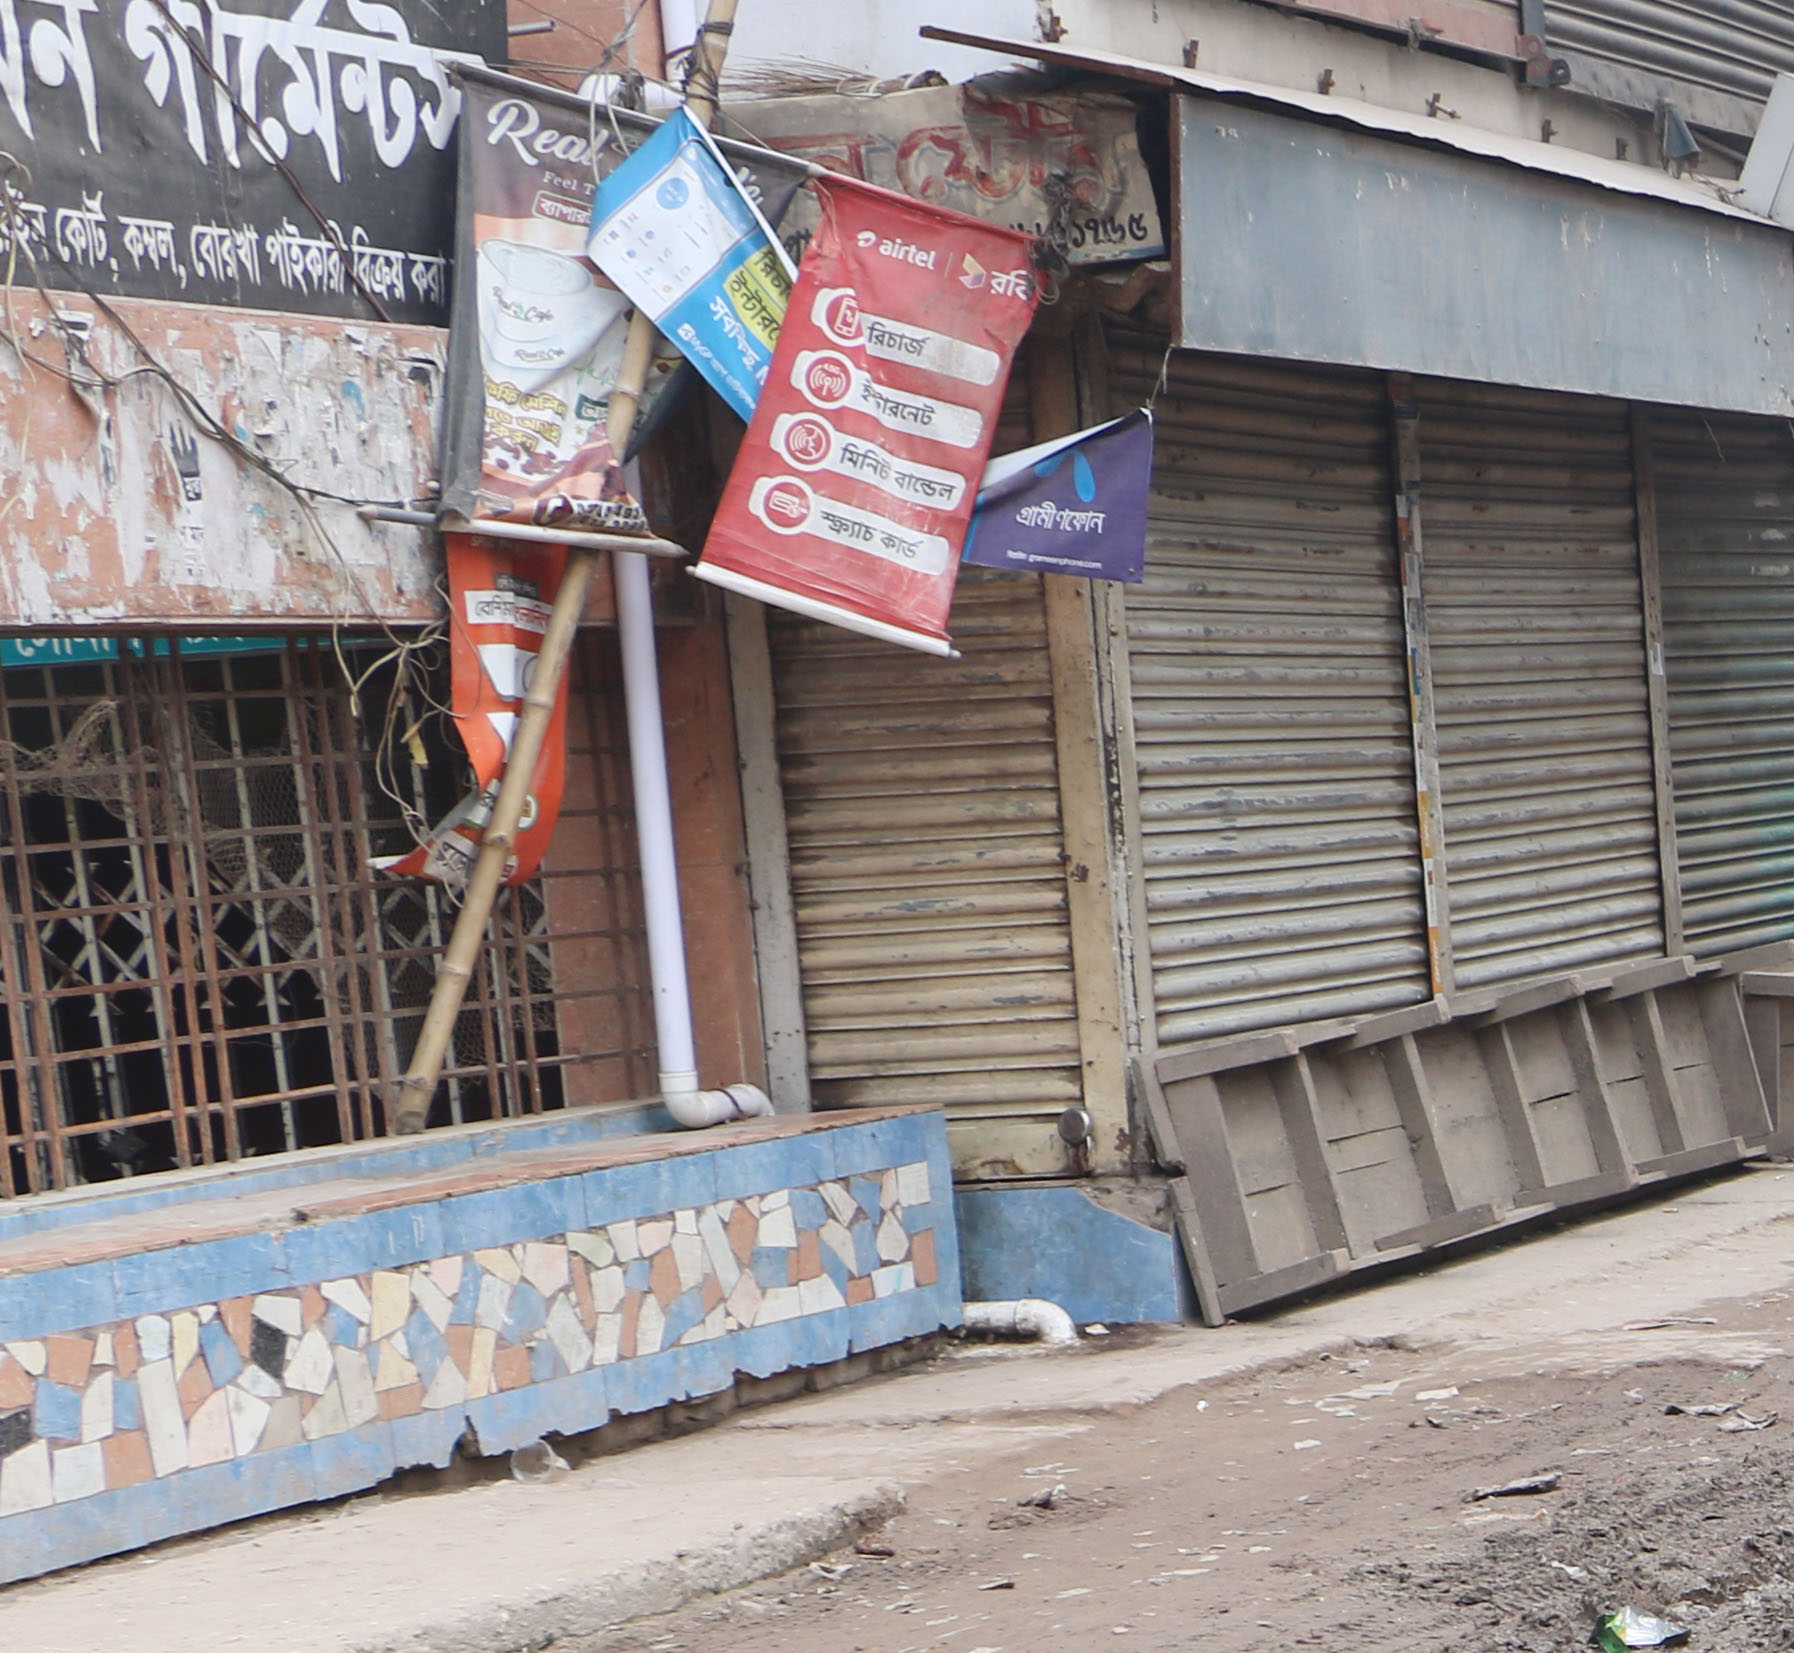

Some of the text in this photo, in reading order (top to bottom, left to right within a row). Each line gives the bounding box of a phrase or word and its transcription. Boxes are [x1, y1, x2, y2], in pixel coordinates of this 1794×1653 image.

[487, 99, 610, 166] Real
[543, 171, 577, 192] Feel
[191, 218, 261, 286] বোরখা
[878, 237, 937, 271] airtel
[867, 322, 932, 358] রিচার্জ
[839, 443, 957, 502] মিনিট বান্ডেল
[1015, 500, 1107, 535] গ্রামীণফোন
[880, 532, 926, 561] কার্ড
